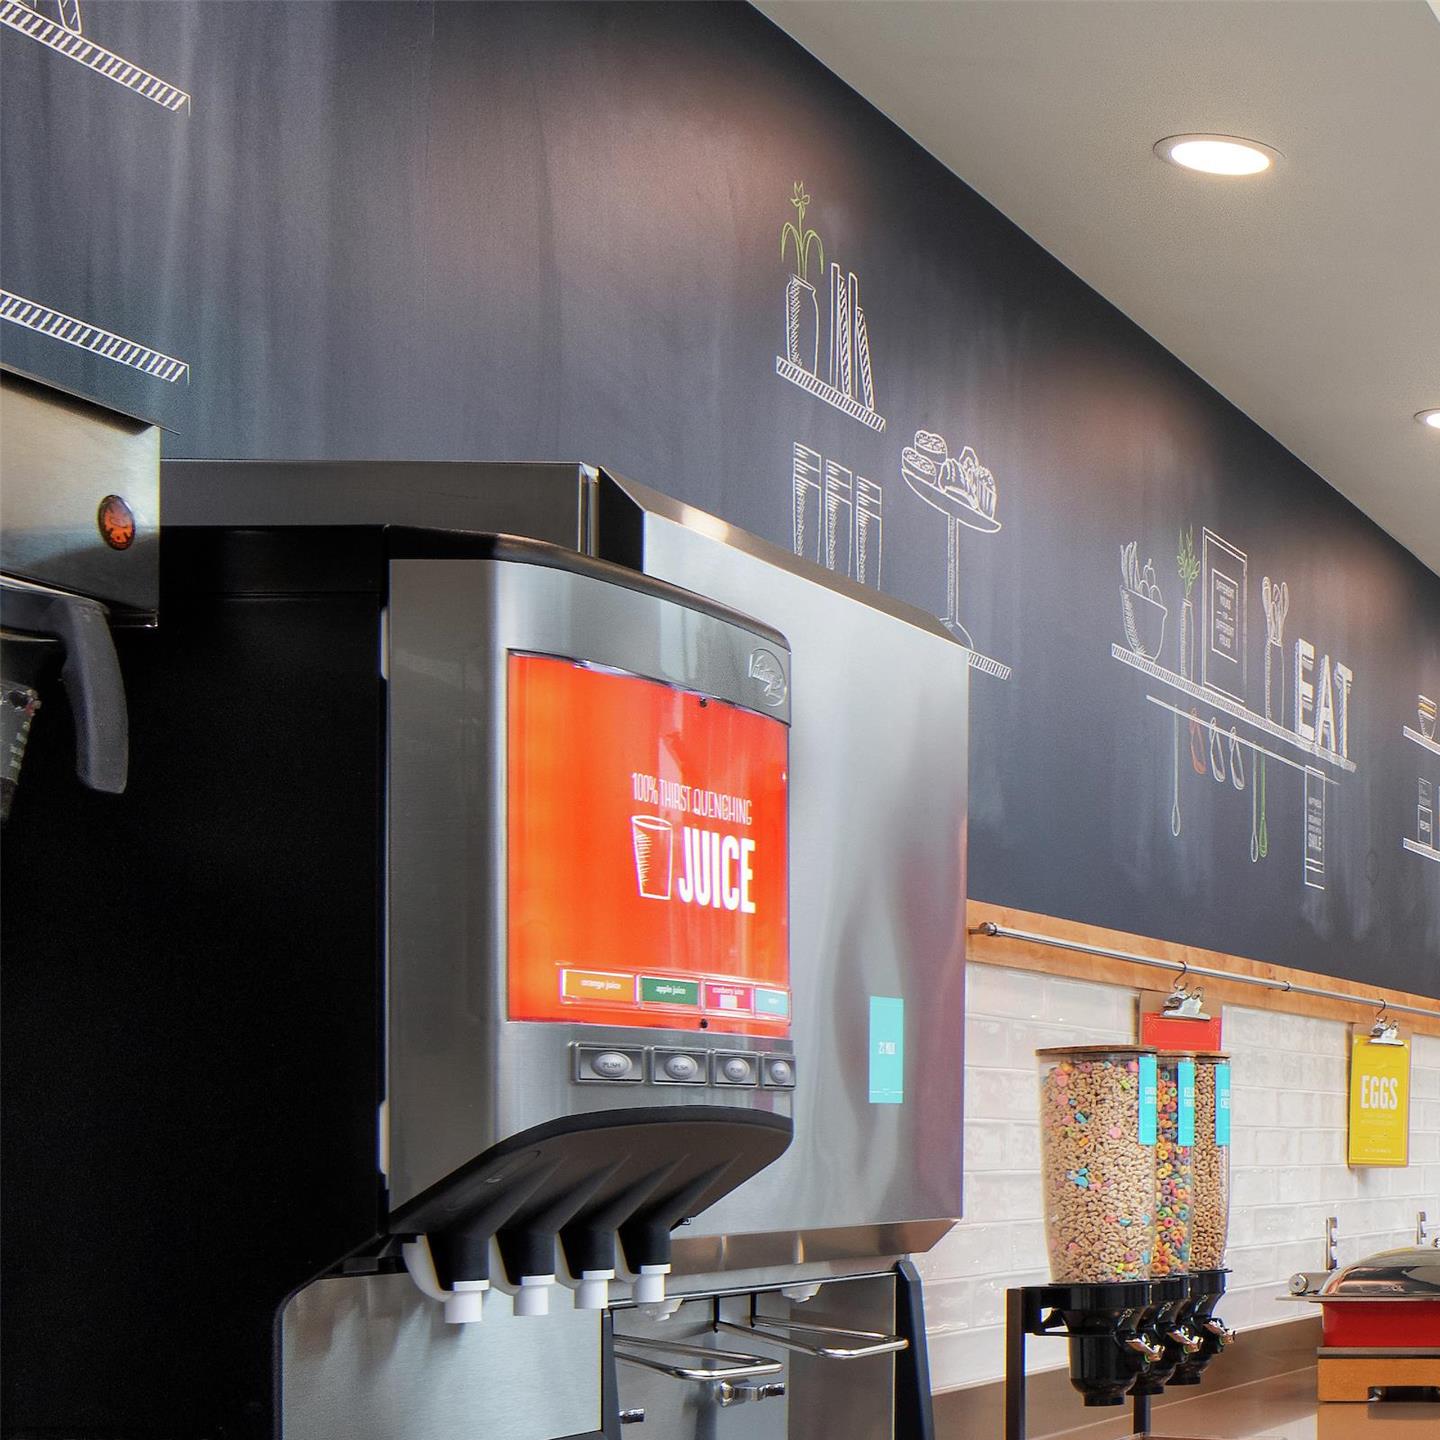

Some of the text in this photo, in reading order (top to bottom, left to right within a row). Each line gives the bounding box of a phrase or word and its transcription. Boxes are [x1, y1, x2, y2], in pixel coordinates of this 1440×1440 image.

[1294, 638, 1353, 760] EAT
[631, 771, 753, 826] 100% THIRST QUENCHING
[677, 826, 756, 914] JUICE
[602, 1061, 621, 1069] PUSH
[673, 1063, 690, 1071] PUSH
[1360, 1074, 1399, 1111] EGGS
